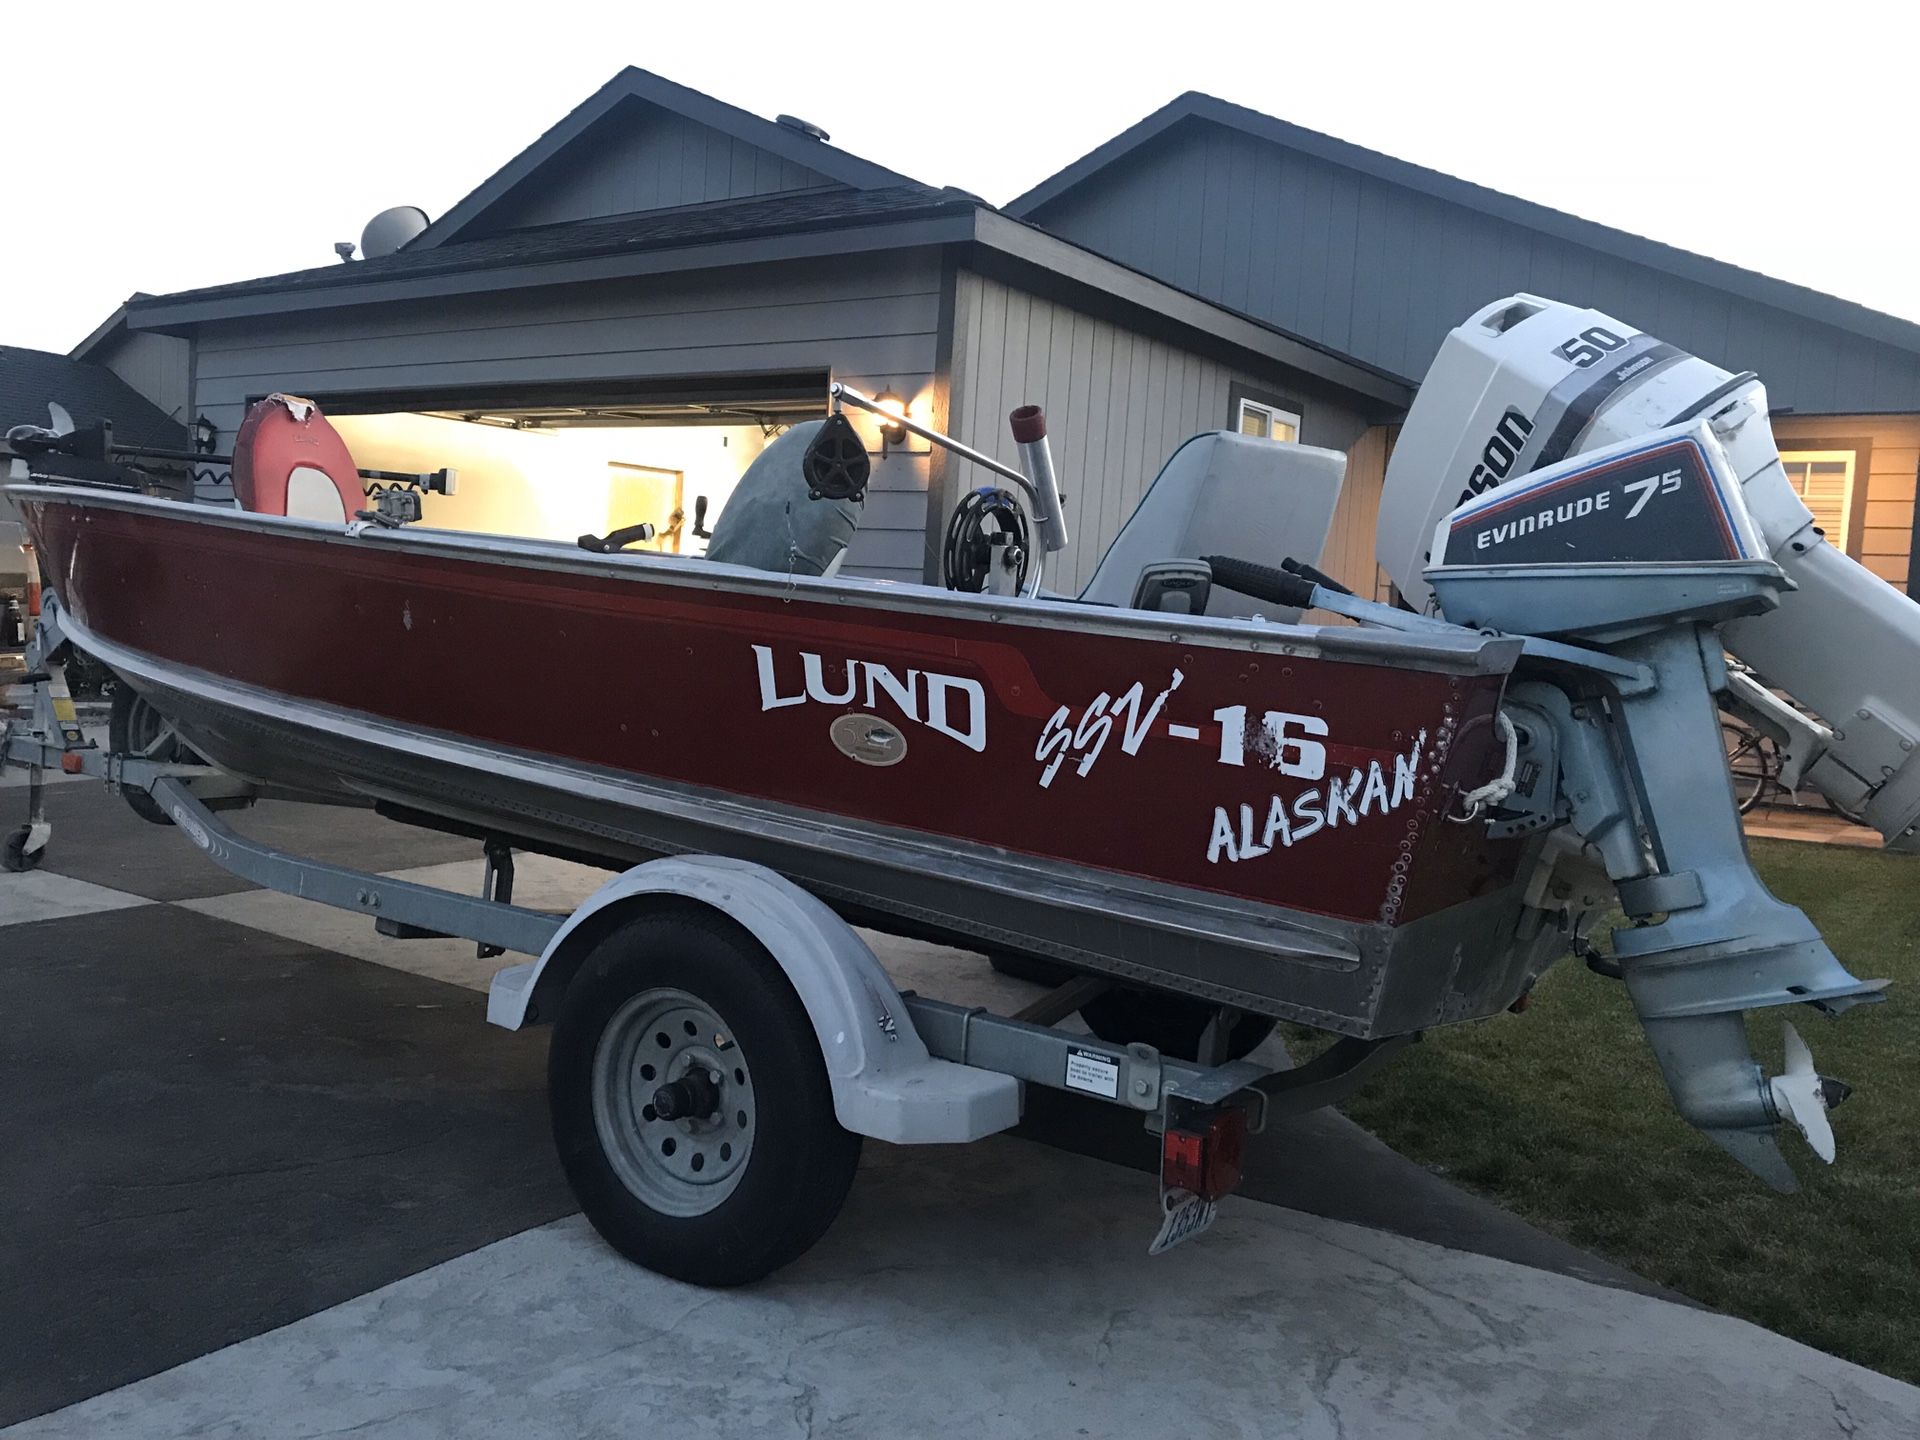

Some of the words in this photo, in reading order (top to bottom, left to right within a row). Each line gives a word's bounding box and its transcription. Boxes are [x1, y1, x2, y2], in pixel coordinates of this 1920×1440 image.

[1560, 326, 1629, 369] 50
[1476, 490, 1611, 551] EVINRUDE
[750, 643, 987, 753] LUND
[1205, 726, 1428, 865] ALASKAN
[1082, 1051, 1111, 1063] WARNING
